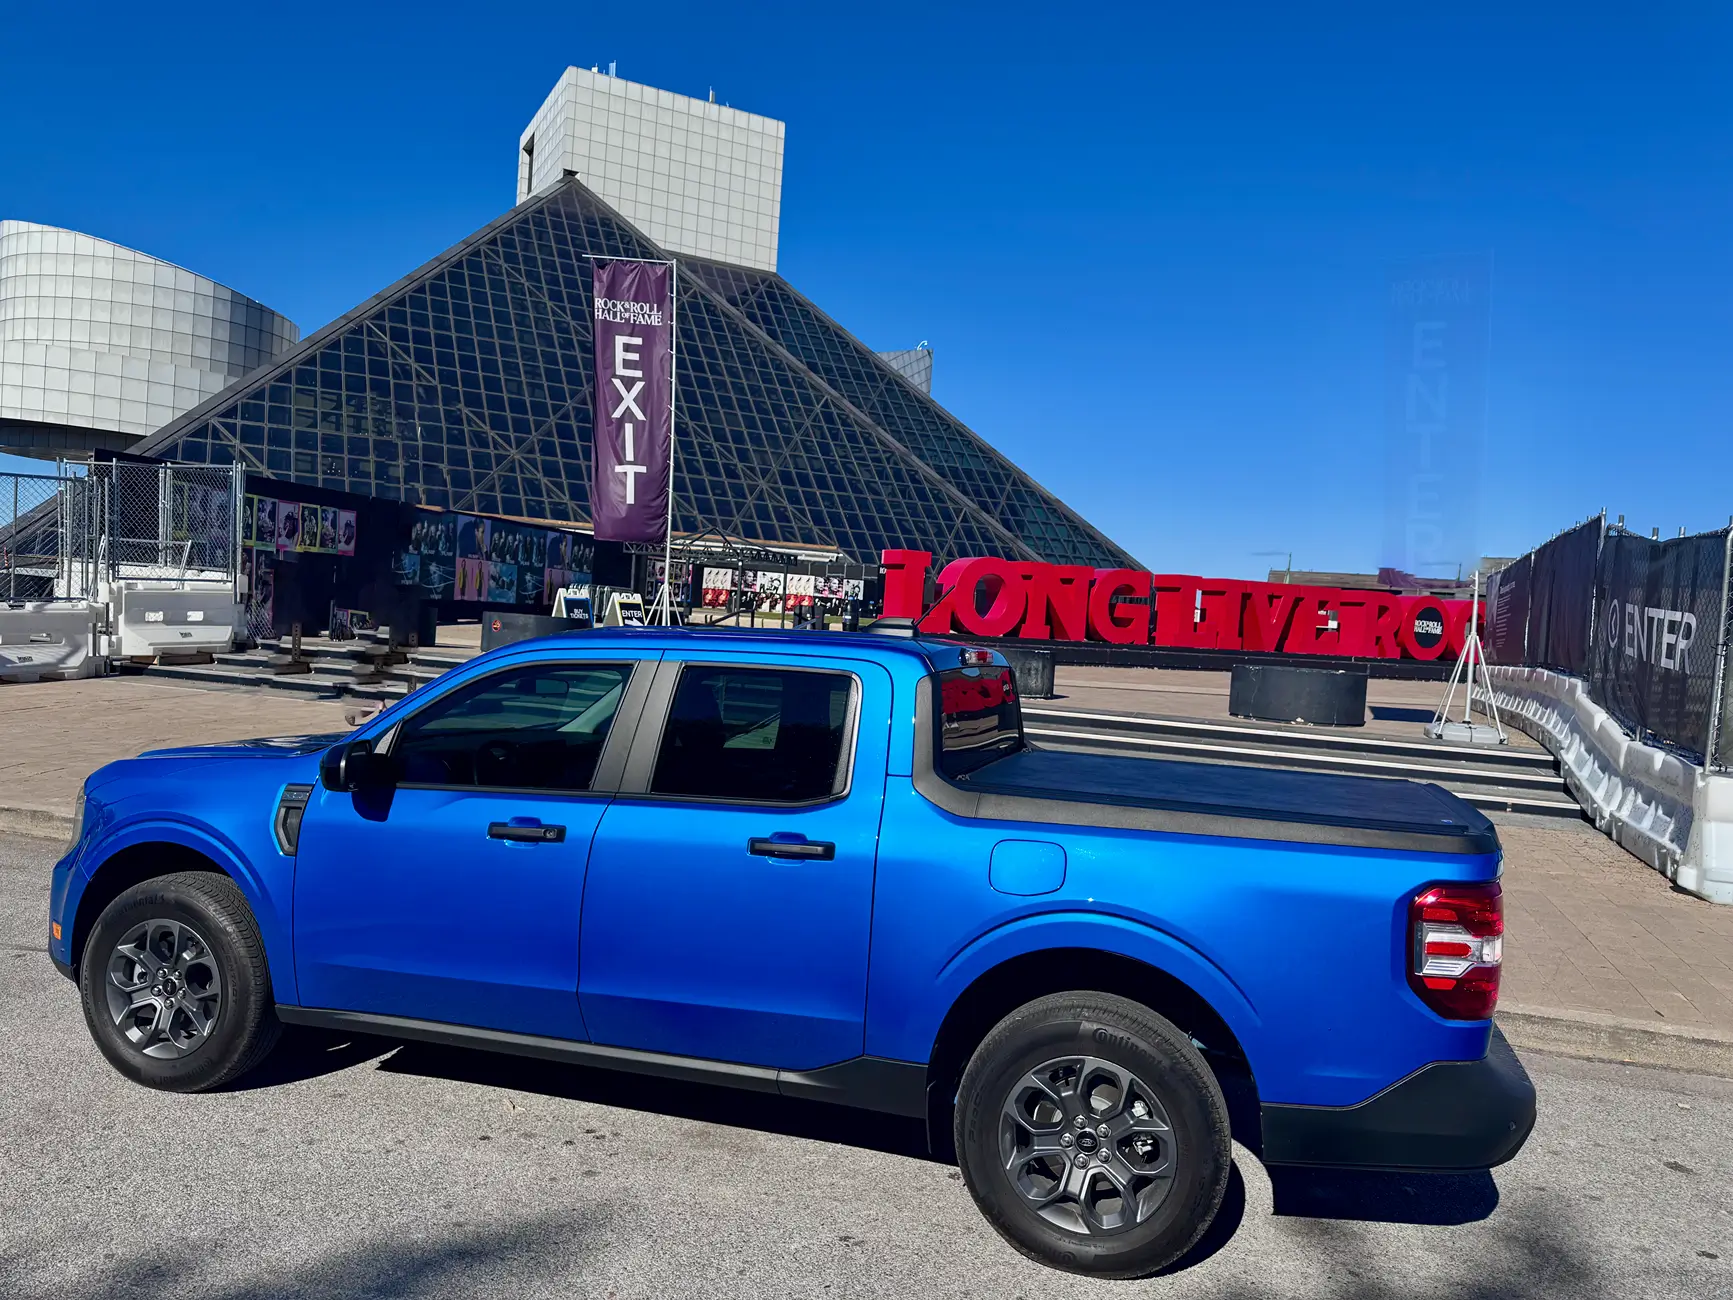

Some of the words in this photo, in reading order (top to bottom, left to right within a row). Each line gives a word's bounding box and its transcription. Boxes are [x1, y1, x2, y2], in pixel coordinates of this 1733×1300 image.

[594, 308, 625, 323] HALL
[629, 313, 663, 326] FAME
[611, 335, 647, 504] EXIT
[621, 610, 643, 618] ENTER
[877, 549, 1151, 645] LONG
[1153, 574, 1343, 656] LIVE
[1339, 590, 1486, 664] ROC
[1625, 602, 1697, 674] ENTER
[1092, 1028, 1167, 1072] Continent
